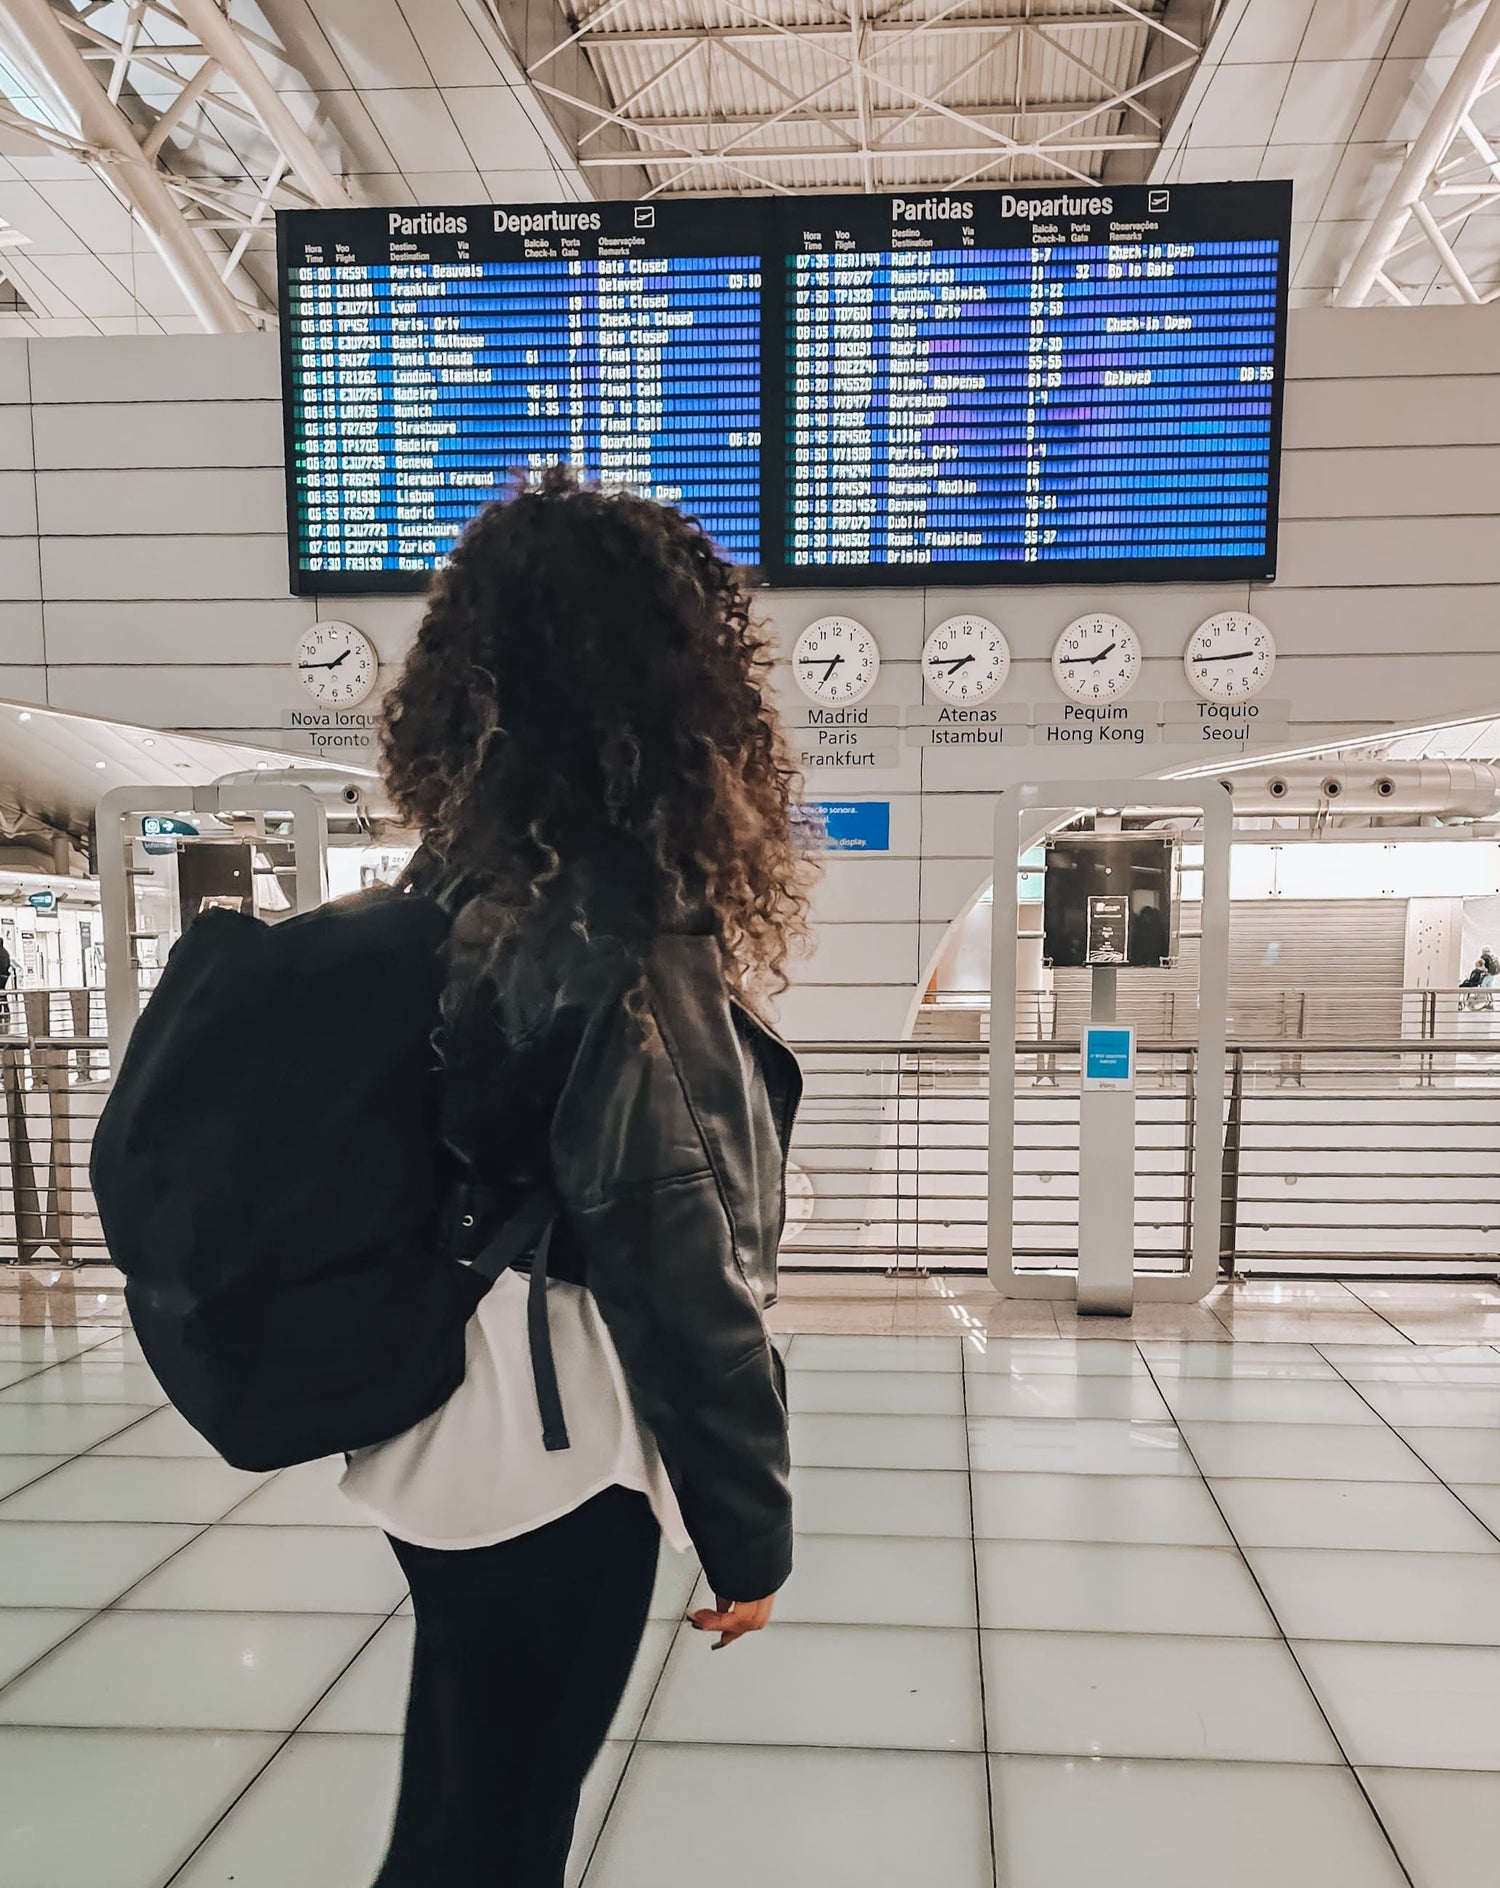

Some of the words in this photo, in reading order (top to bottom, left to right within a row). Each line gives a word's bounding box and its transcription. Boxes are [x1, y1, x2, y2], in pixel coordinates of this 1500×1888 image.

[893, 198, 973, 221] Partidas
[1001, 195, 1113, 220] Departures
[389, 213, 467, 234] Partidas
[494, 211, 600, 235] Departures
[1071, 223, 1091, 232] Porta
[803, 231, 821, 240] Hora
[835, 230, 850, 239] Voo
[891, 228, 920, 237] Destino
[962, 226, 975, 235] Via
[1071, 233, 1089, 242] Gate
[1109, 231, 1142, 241] Remarks
[390, 242, 418, 251] Destino
[457, 241, 469, 249] Via
[561, 238, 581, 247] Porta
[804, 241, 822, 250] Time
[835, 240, 856, 250] Flight
[891, 239, 933, 248] Destination
[962, 236, 975, 245] Via
[305, 244, 323, 253] Hora
[335, 244, 350, 252] Voo
[562, 248, 579, 257] Gate
[598, 247, 630, 256] Remarks
[1167, 244, 1194, 258] Open
[305, 254, 323, 263] Time
[335, 253, 356, 263] Flight
[390, 252, 430, 261] Destination
[458, 251, 469, 260] Via
[797, 254, 829, 268] 07:35
[891, 252, 930, 266] Madrid
[299, 267, 331, 280] 06:00
[432, 264, 483, 278] Beauvais
[598, 260, 625, 274] Gate
[629, 259, 668, 273] Closed
[1108, 264, 1123, 279] Go
[1128, 263, 1141, 277] to
[1146, 262, 1174, 277] Gate
[797, 272, 829, 286] 07:45
[891, 269, 955, 284] Maastricht
[300, 284, 331, 298] 06:00
[391, 282, 446, 296] Frankfurt
[598, 277, 644, 292] Delayed
[797, 290, 828, 304] 07:50
[941, 286, 987, 301] Gatwick
[301, 302, 332, 315] 06:00
[391, 301, 417, 314] Lyon
[598, 296, 625, 310] Gate
[630, 295, 668, 308] Closed
[934, 304, 961, 319] Orly
[301, 319, 333, 332] 06:05
[433, 317, 460, 330] Orly
[655, 312, 694, 326] Closed
[1164, 316, 1192, 330] Open
[891, 323, 917, 337] Dole
[434, 334, 485, 348] Mulhouse
[599, 331, 625, 345] Gate
[630, 330, 668, 344] Closed
[600, 348, 631, 362] Final
[637, 347, 662, 361] Call
[889, 341, 930, 355] Madrid
[302, 354, 333, 367] 06:10
[428, 351, 474, 366] Delgada
[600, 366, 631, 380] Final
[637, 365, 662, 379] Call
[889, 359, 929, 373] Nantes
[303, 371, 334, 384] 06:15
[441, 369, 492, 382] Stansted
[1103, 370, 1152, 386] Delayed
[600, 383, 631, 397] Final
[637, 382, 662, 396] Call
[933, 376, 986, 390] Malpensa
[394, 387, 438, 401] Madeira
[889, 393, 948, 408] Barcelona
[394, 404, 433, 418] Munich
[600, 401, 614, 414] Go
[619, 401, 632, 414] to
[637, 400, 663, 414] Gate
[601, 418, 631, 432] Final
[637, 417, 662, 431] Call
[889, 411, 934, 425] Billund
[395, 421, 456, 434] Strasbourg
[600, 435, 651, 449] Boarding
[729, 433, 761, 446] 06:20
[889, 429, 921, 443] Lille
[395, 438, 439, 452] Madeira
[932, 445, 959, 459] Orly
[396, 456, 434, 469] Geneva
[600, 452, 651, 466] Boarding
[796, 465, 828, 479] 09:05
[889, 463, 939, 477] Budapest
[396, 472, 445, 486] Clermont
[449, 472, 493, 486] Ferrand
[656, 485, 682, 499] Open
[796, 483, 827, 496] 09:10
[937, 480, 977, 494] Modlin
[397, 490, 435, 503] Lisbon
[888, 498, 927, 513] Geneva
[397, 506, 434, 520] Madrid
[398, 523, 460, 537] Luxembourg
[888, 516, 925, 530] Dublin
[925, 532, 982, 546] Fiumicino
[399, 540, 436, 554] Zurich
[888, 550, 931, 564] Bristol
[832, 627, 842, 637] 12
[962, 626, 972, 635] 12
[1093, 624, 1102, 634] 12
[1226, 623, 1236, 632] 12
[808, 708, 868, 724] Madrid
[938, 707, 997, 722] Atenas
[1064, 704, 1128, 724] Pequim
[1197, 702, 1259, 721] Tóquio
[291, 712, 330, 726] Nova
[335, 712, 376, 728] Iorqu
[309, 732, 370, 746] Toronto
[818, 730, 857, 745] Paris
[932, 728, 1003, 743] Istambul
[1047, 726, 1093, 744] Hong
[1099, 726, 1144, 744] Kong
[1203, 725, 1249, 741] Seoul
[801, 752, 875, 766] Frankfurt
